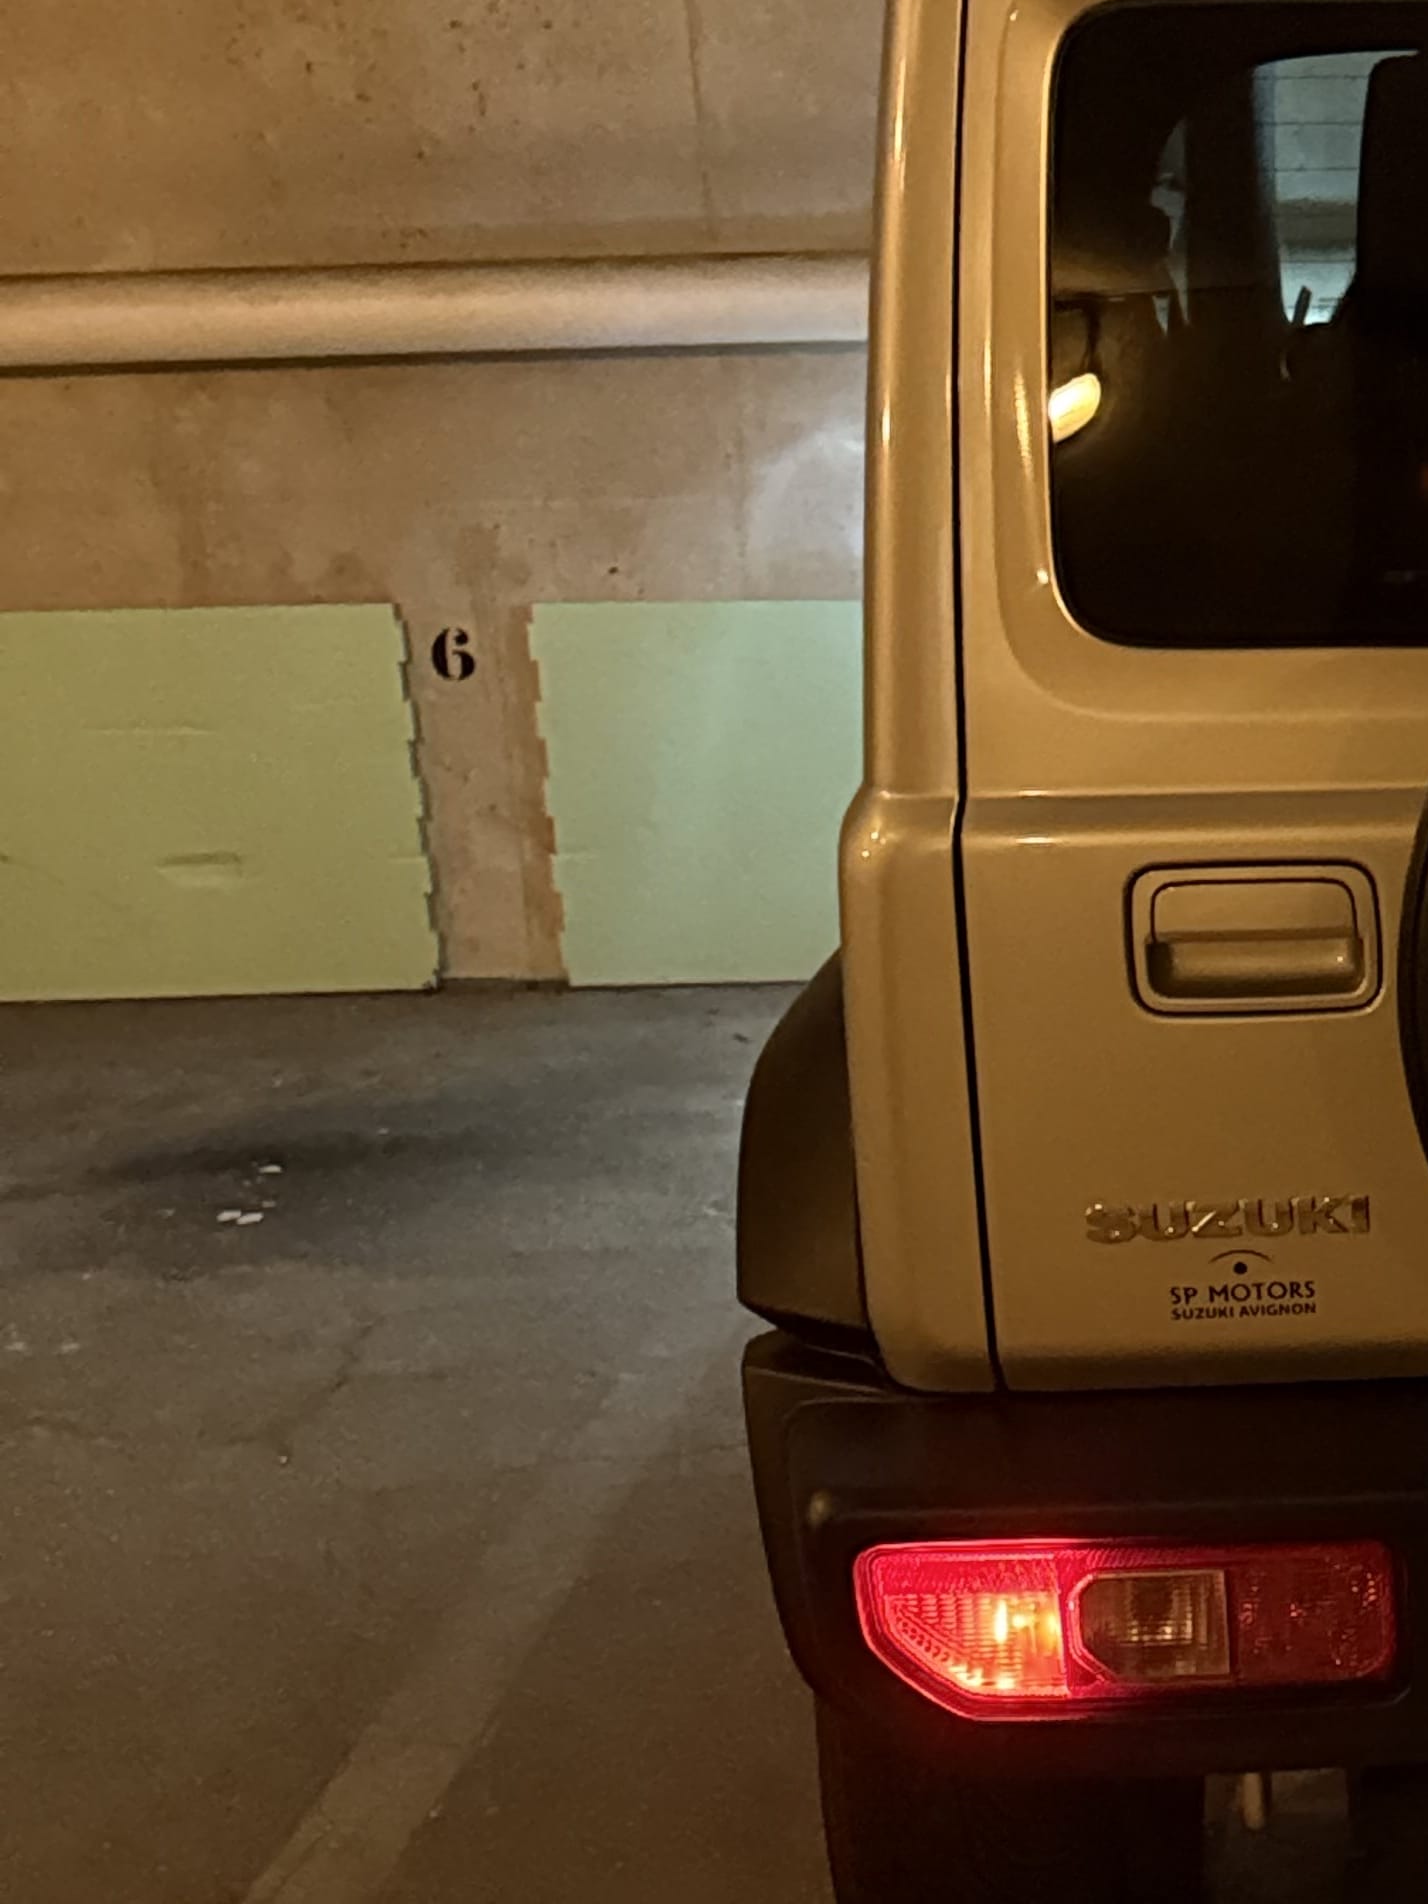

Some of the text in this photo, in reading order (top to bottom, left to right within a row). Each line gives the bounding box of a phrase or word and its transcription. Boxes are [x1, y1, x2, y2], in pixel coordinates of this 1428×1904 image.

[431, 627, 476, 682] 6
[1085, 1195, 1371, 1244] SUZUKI
[1170, 1281, 1315, 1305] SP MOTORS
[1171, 1302, 1316, 1320] SUZUKI AVIGNON
